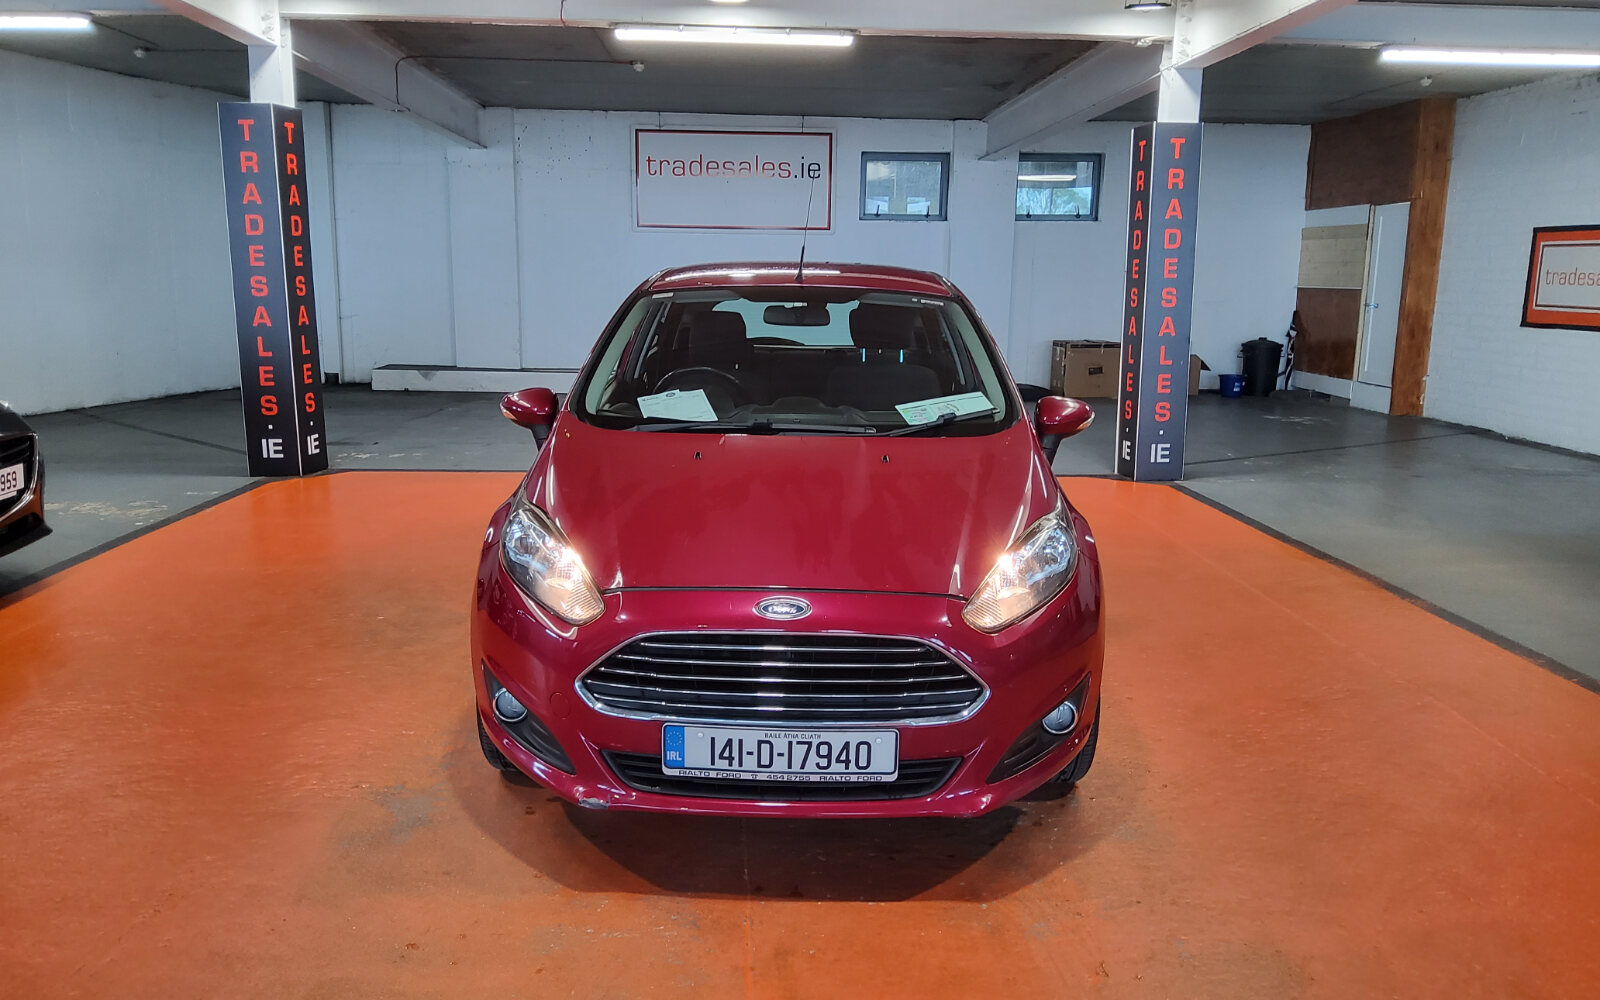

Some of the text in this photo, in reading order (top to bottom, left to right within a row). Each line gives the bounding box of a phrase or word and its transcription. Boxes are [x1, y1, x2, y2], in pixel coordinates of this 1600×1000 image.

[645, 153, 821, 179] tradesales.ie
[0, 470, 18, 492] 959
[666, 750, 683, 761] IRL
[710, 736, 872, 771] 141-D-17940
[678, 769, 711, 777] RIALTO
[715, 771, 742, 779] FORD
